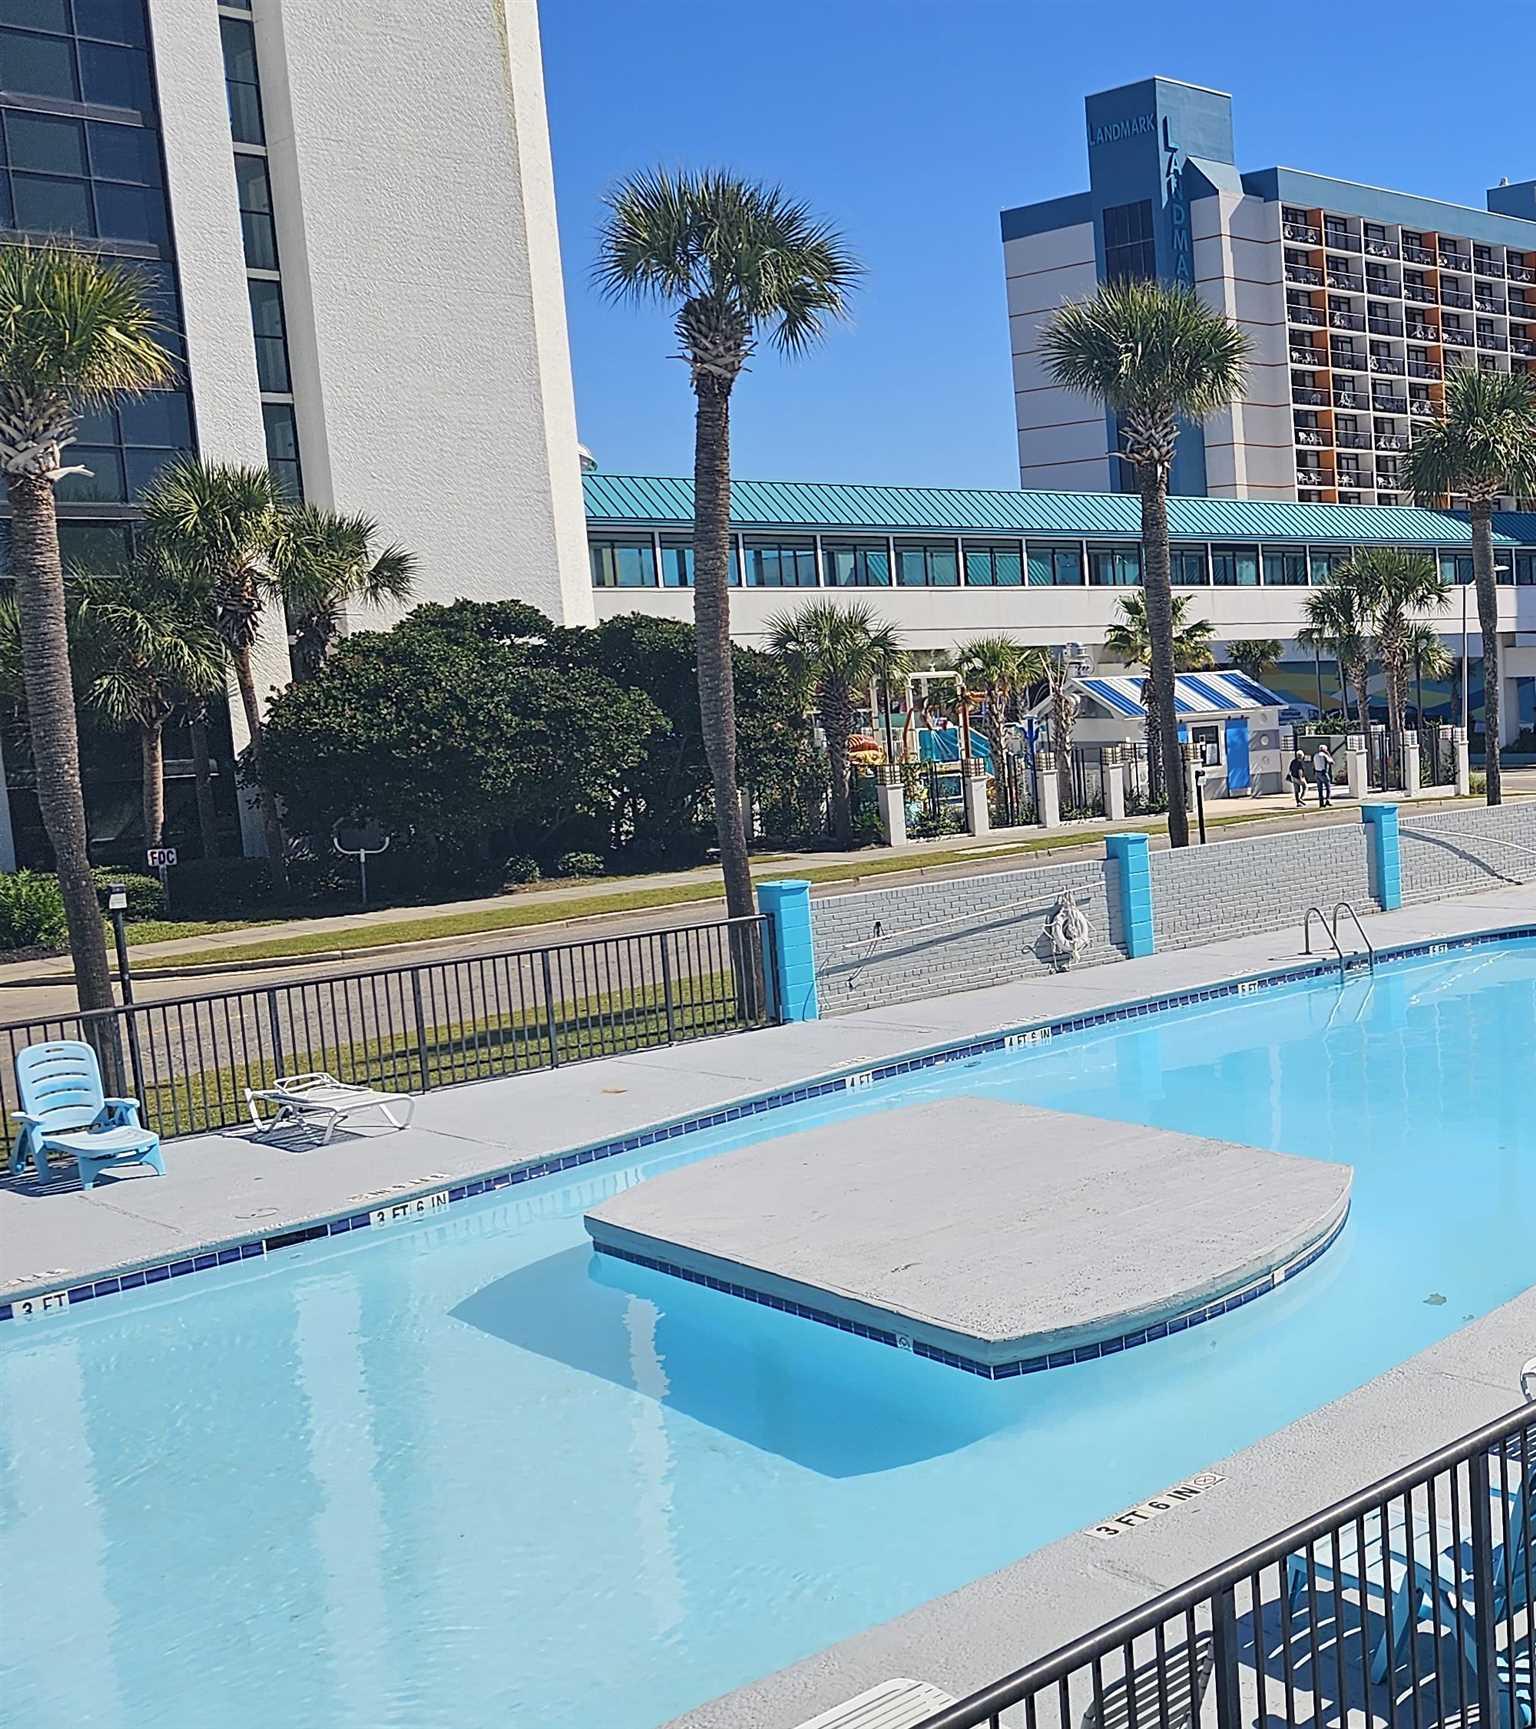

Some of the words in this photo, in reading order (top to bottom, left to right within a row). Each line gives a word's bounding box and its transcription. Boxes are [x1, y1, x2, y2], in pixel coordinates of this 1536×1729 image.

[1088, 112, 1155, 146] LANDMARK
[1162, 114, 1189, 299] LANDMAR
[150, 849, 175, 865] FDC
[1040, 1029, 1050, 1040] IN
[392, 1204, 409, 1219] FT
[416, 1200, 425, 1212] 6
[431, 1193, 447, 1208] IN
[42, 1292, 66, 1311] FT
[1096, 1526, 1120, 1536] 3
[1114, 1510, 1150, 1527] FT
[1148, 1501, 1171, 1510] 6
[1166, 1486, 1202, 1501] IN
